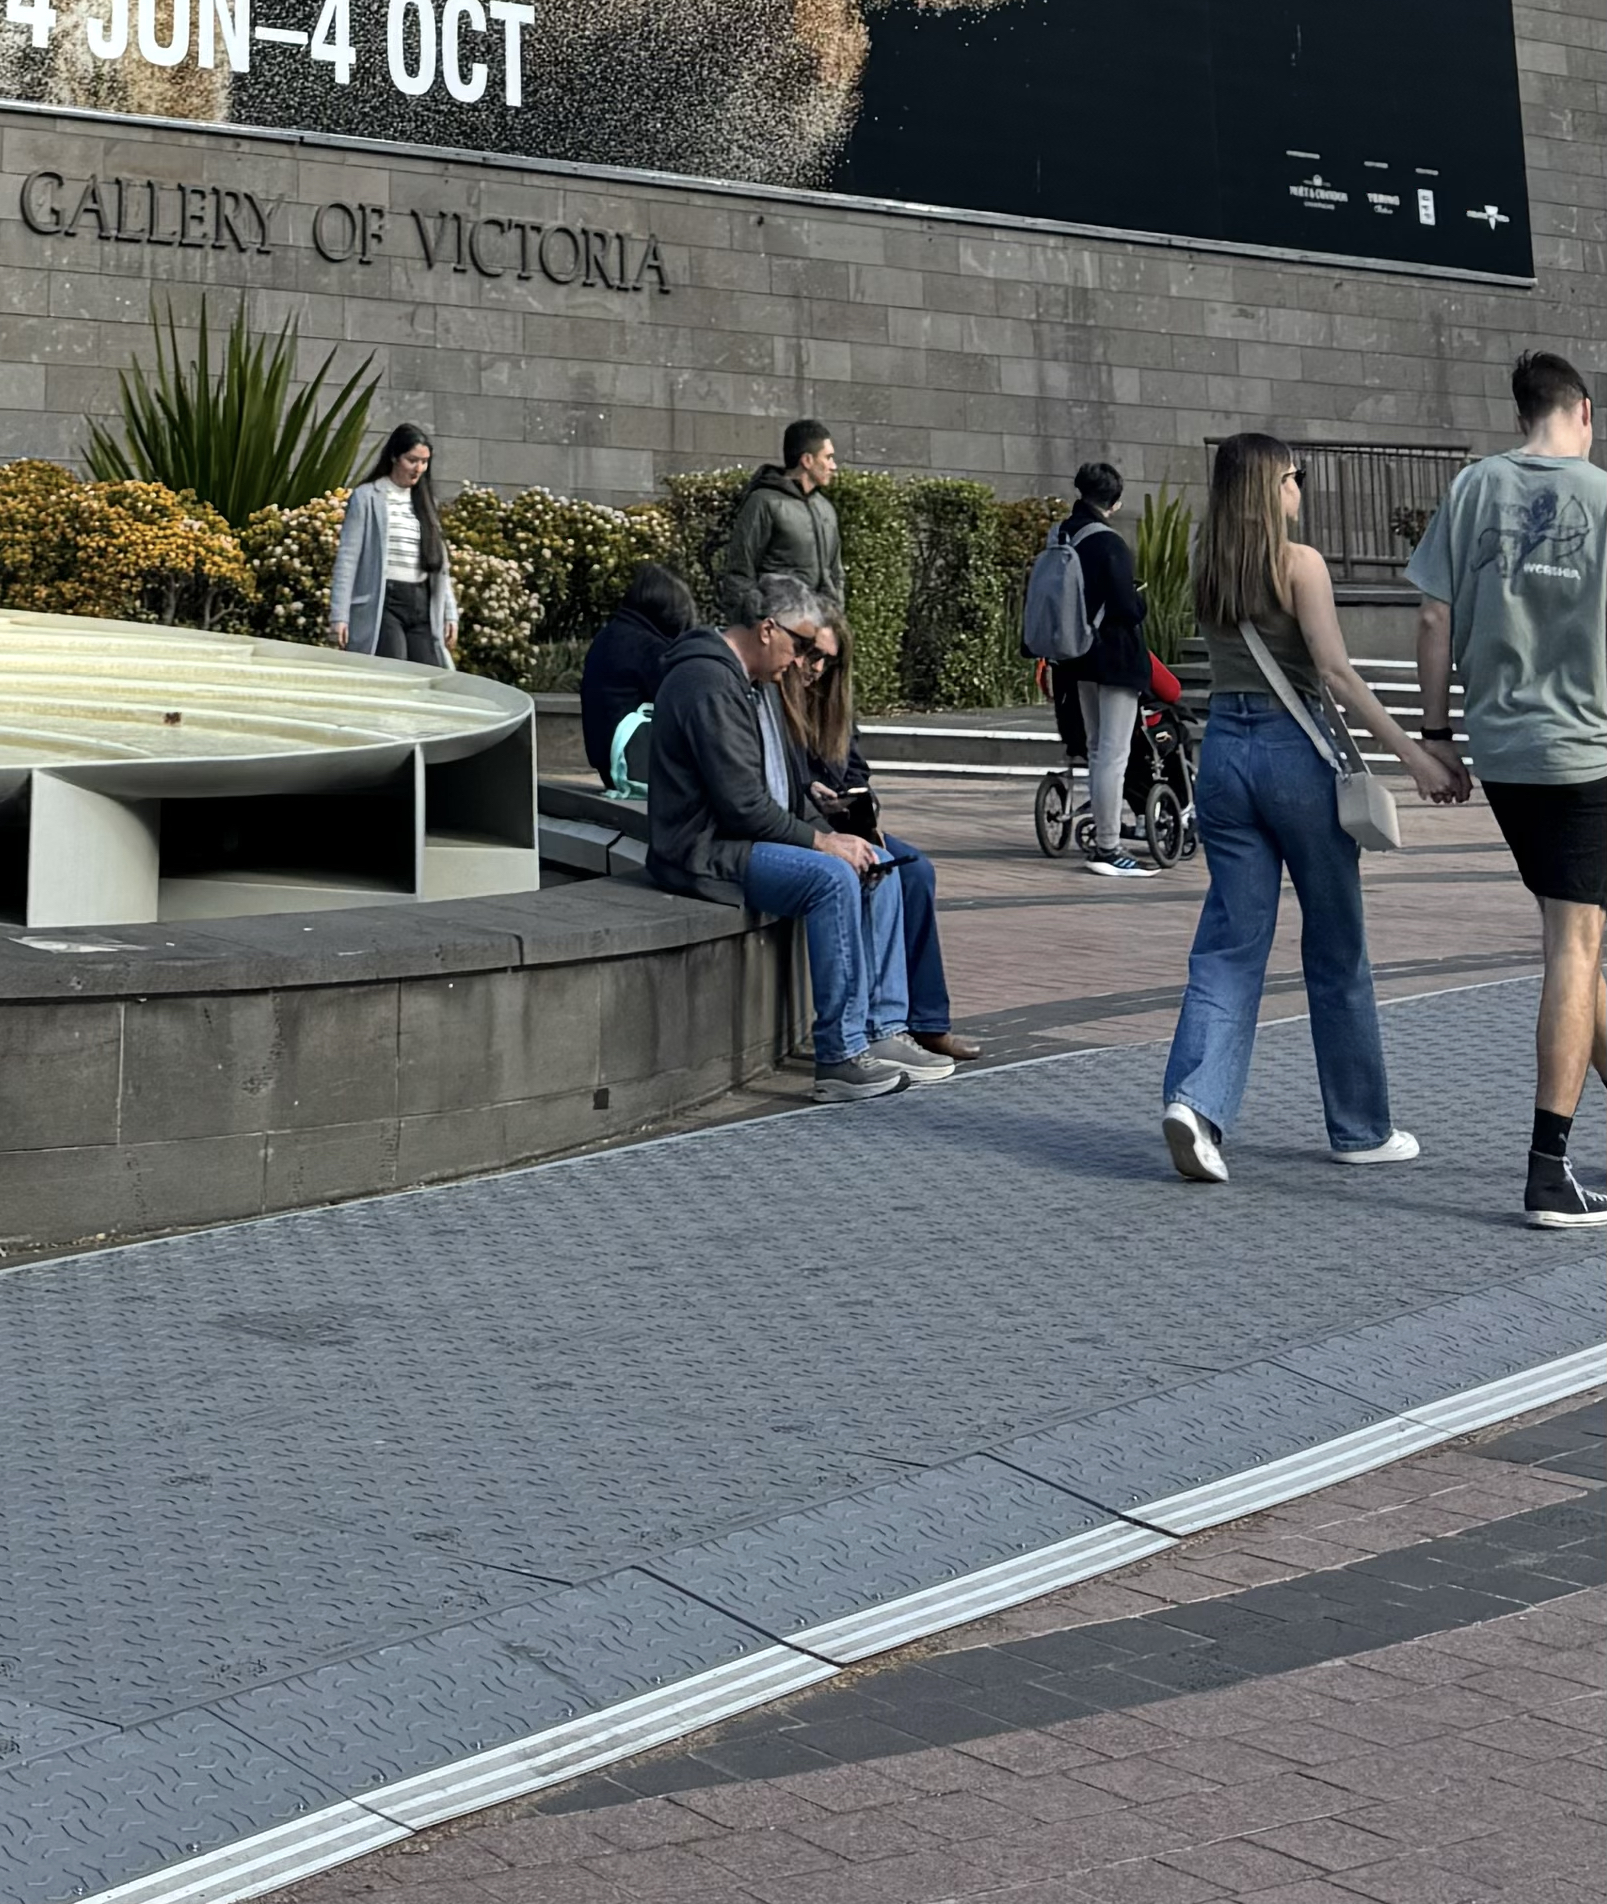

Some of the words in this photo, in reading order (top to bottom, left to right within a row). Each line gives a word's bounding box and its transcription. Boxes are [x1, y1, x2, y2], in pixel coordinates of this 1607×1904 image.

[20, 171, 286, 254] GALLERY
[312, 202, 385, 265] OF
[410, 208, 671, 294] VICTORIA
